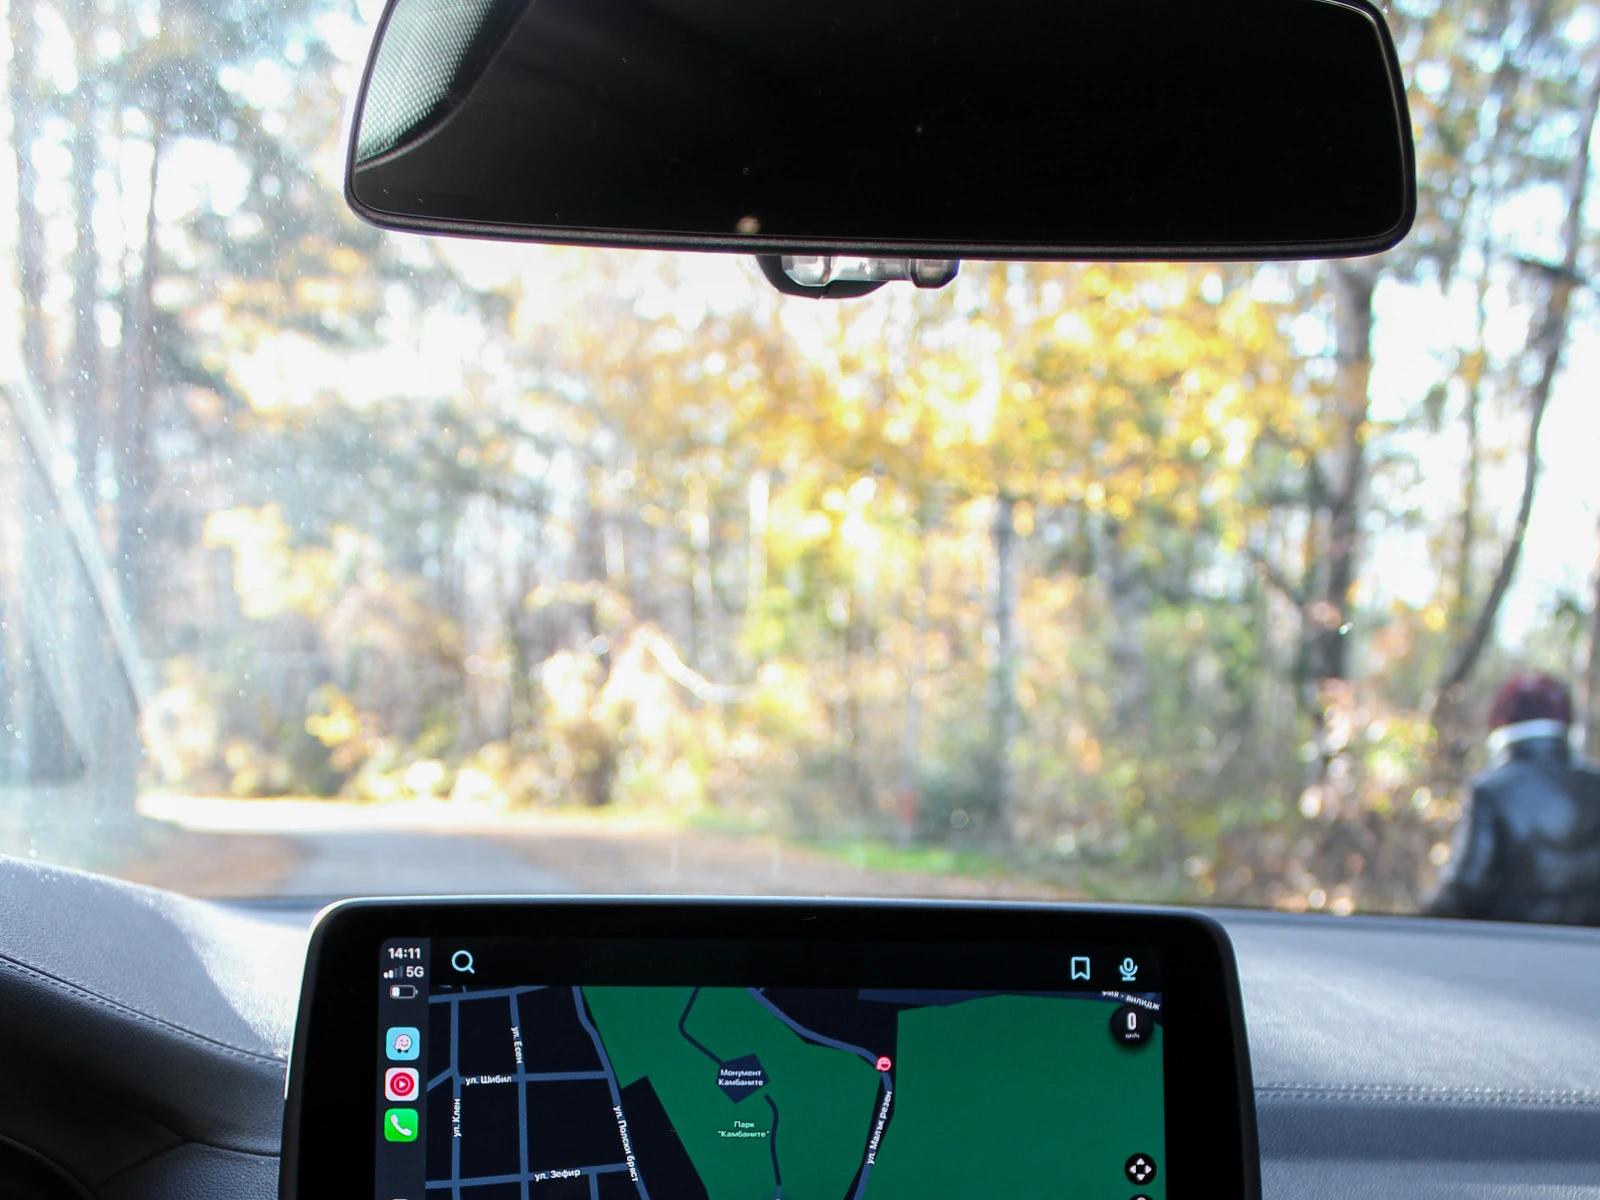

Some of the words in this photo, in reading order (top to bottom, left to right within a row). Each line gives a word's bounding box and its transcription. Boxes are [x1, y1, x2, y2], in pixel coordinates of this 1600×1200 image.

[388, 948, 420, 959] 14:11
[406, 966, 424, 978] 5G
[1128, 1012, 1137, 1030] 0
[514, 1041, 522, 1064] Есен
[720, 1069, 762, 1077] Монумент
[480, 1075, 512, 1084] Шибил
[452, 1099, 460, 1122] Клен
[880, 1090, 892, 1119] резен
[734, 1120, 755, 1128] Парк
[618, 1120, 632, 1154] Полски
[550, 1169, 580, 1178] Зефир
